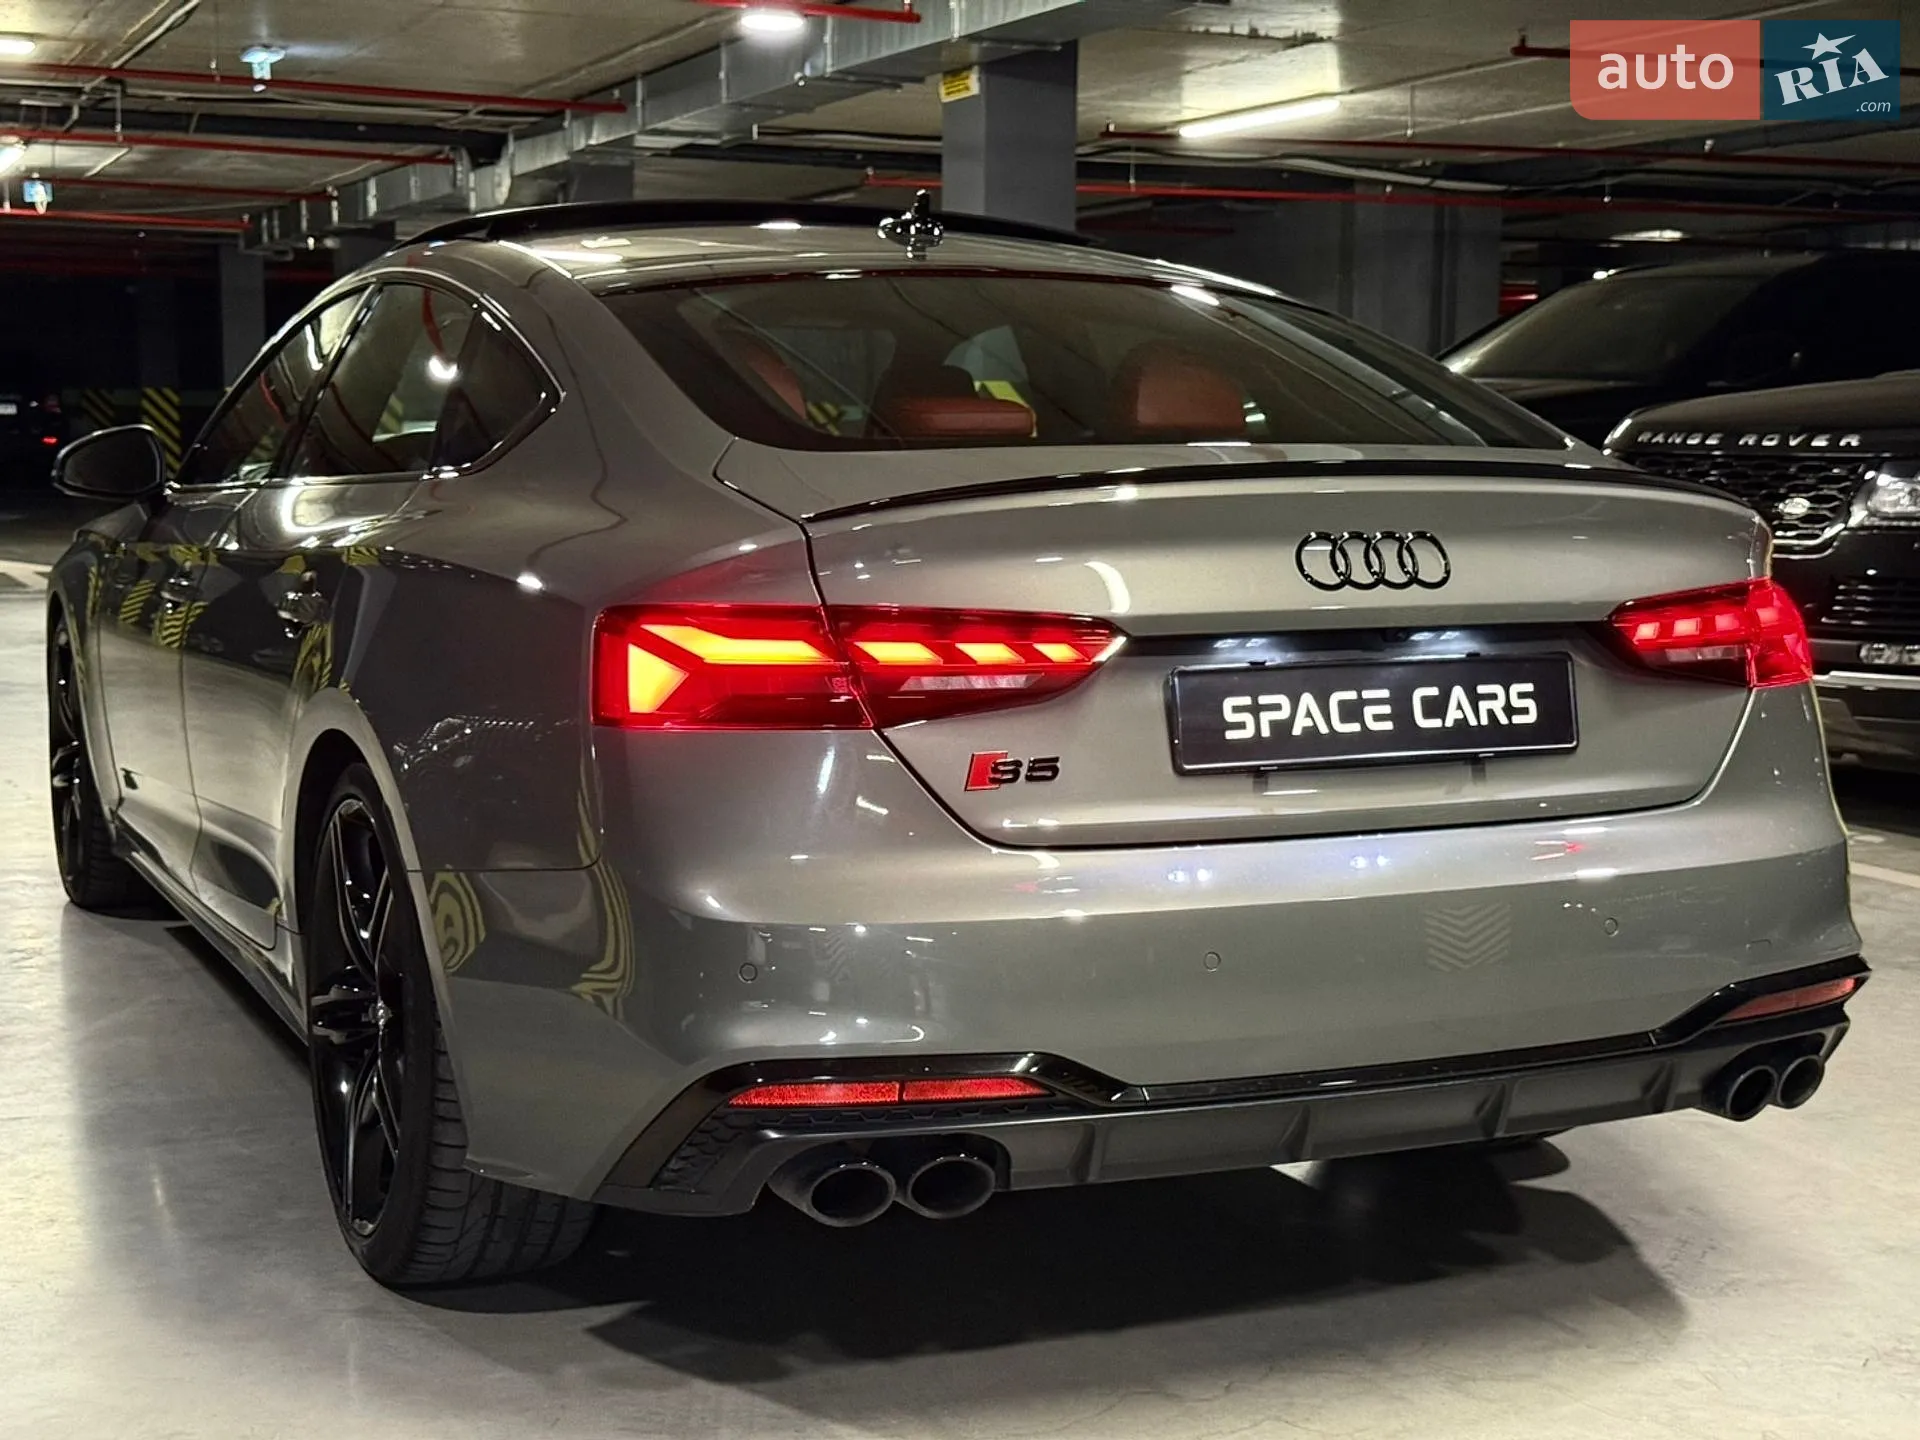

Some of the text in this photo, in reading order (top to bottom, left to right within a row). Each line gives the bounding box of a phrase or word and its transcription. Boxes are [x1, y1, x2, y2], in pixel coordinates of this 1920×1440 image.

[1637, 431, 1862, 447] RANGE ROVER
[1222, 682, 1539, 740] SPACE CARS
[987, 756, 1060, 785] S5
